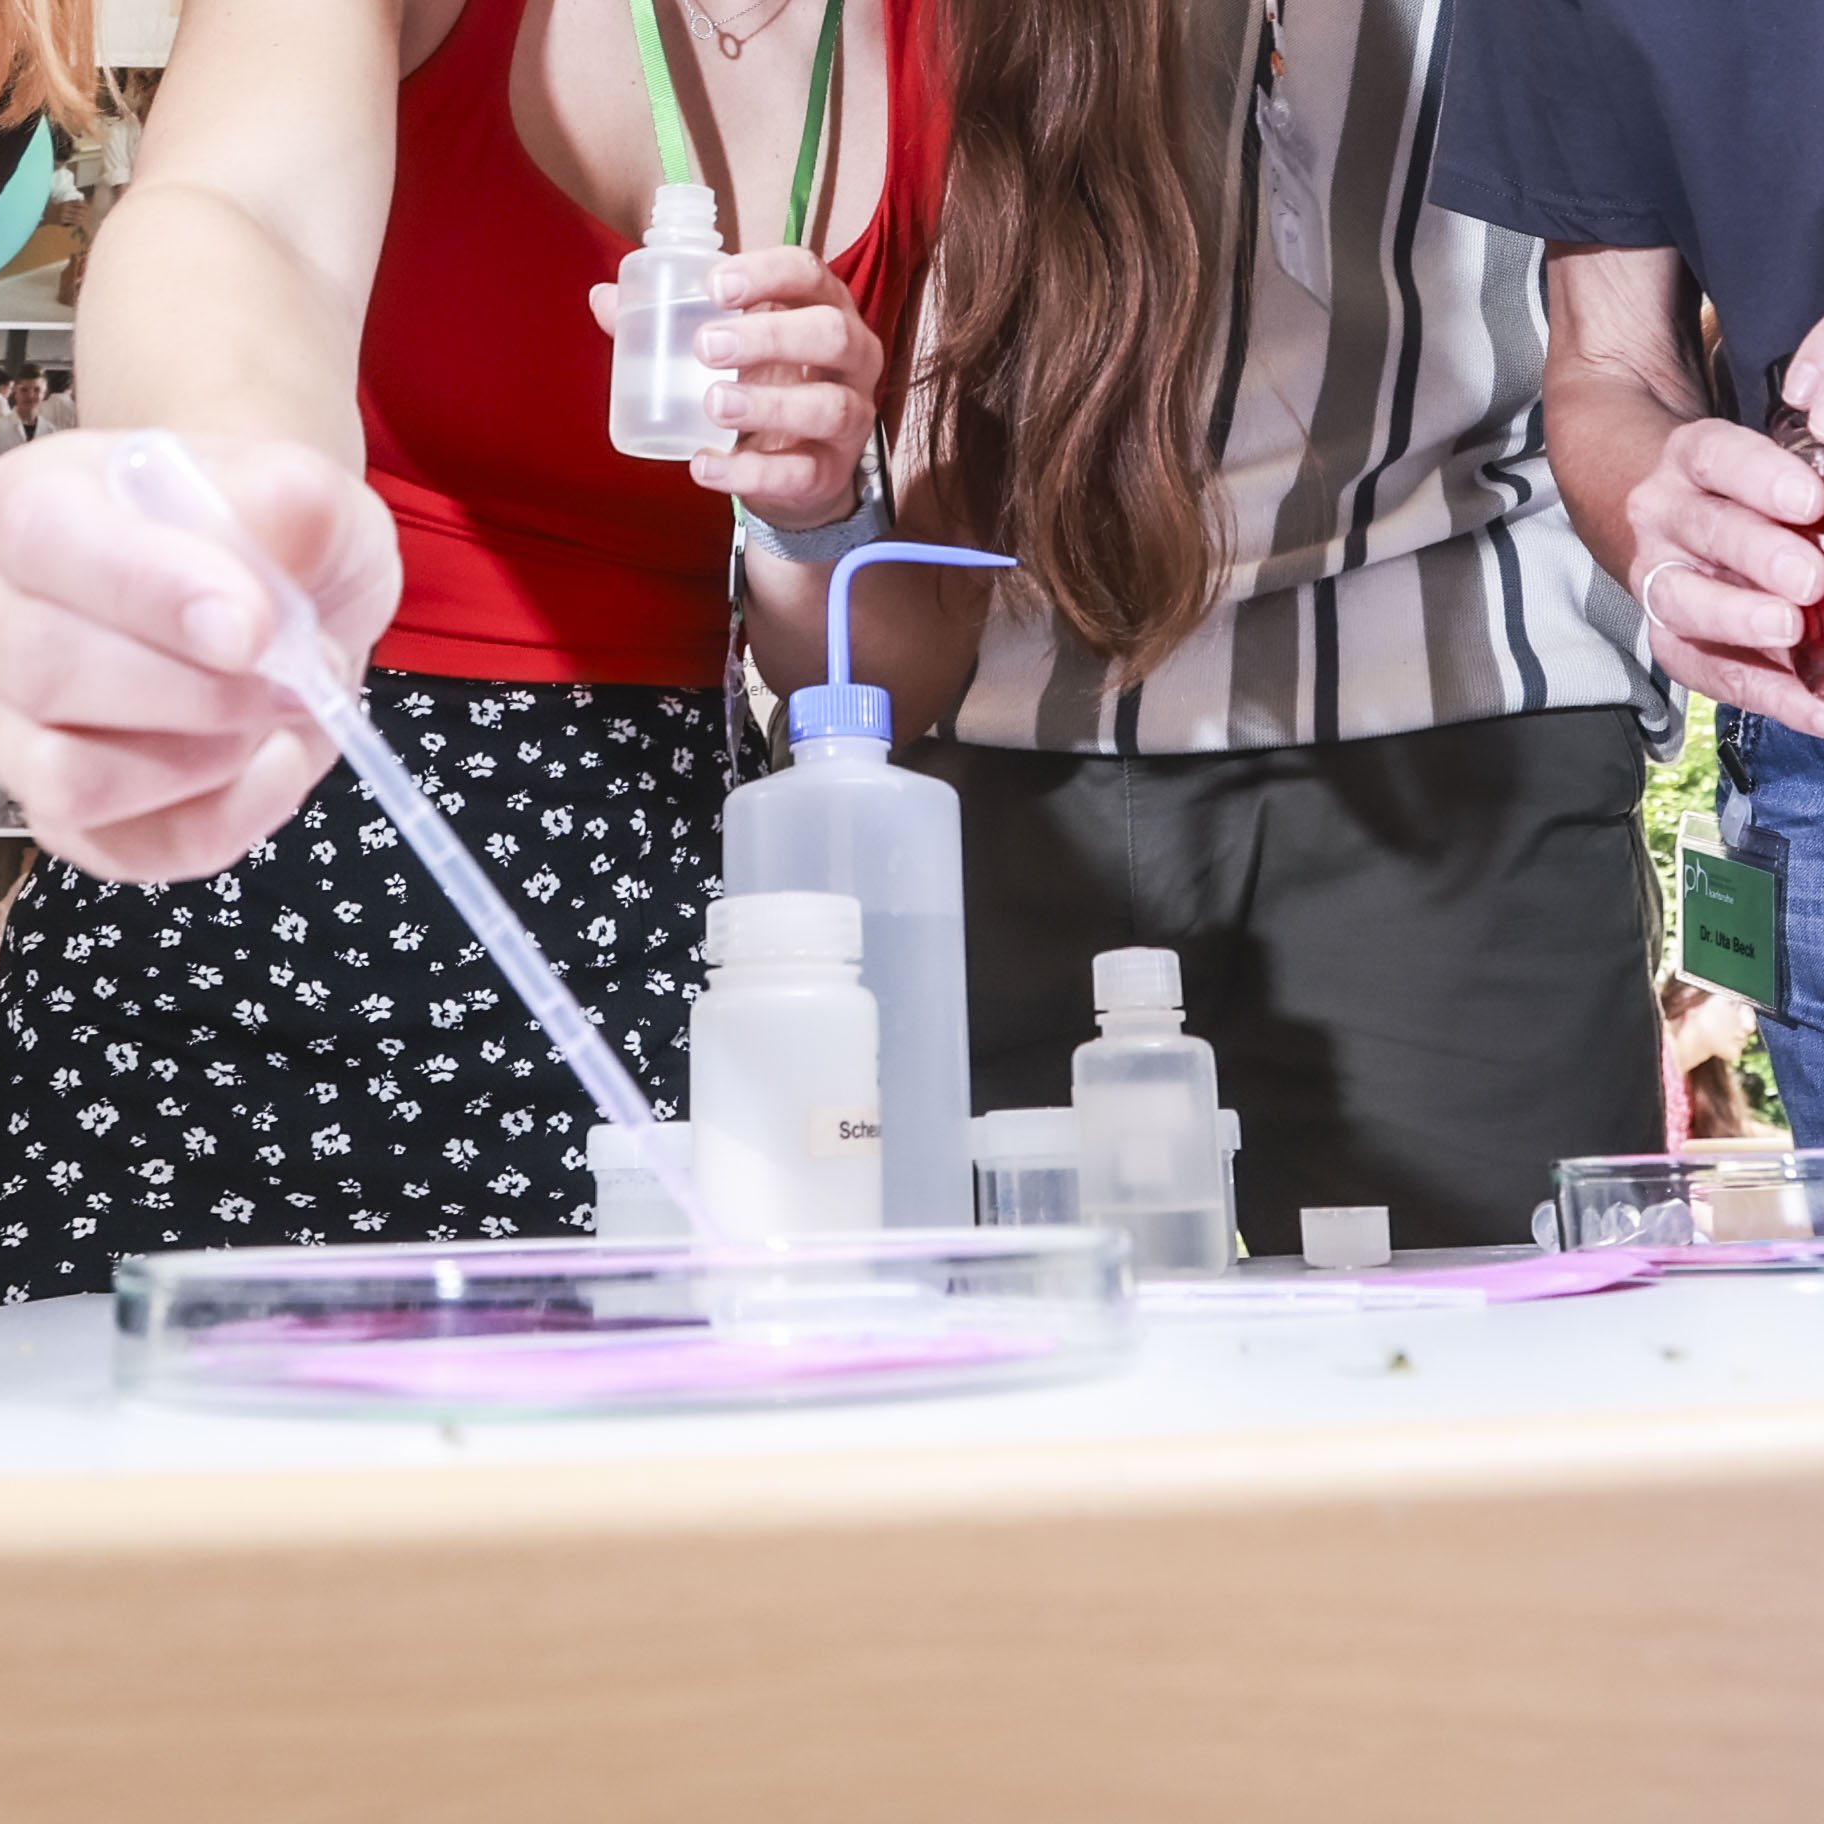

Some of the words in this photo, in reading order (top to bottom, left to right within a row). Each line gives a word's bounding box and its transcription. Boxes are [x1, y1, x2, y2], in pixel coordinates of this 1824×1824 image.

[1684, 857, 1709, 899] ph
[1699, 923, 1713, 944] Dr.
[1715, 929, 1731, 951] Uta
[1733, 936, 1756, 960] Beck
